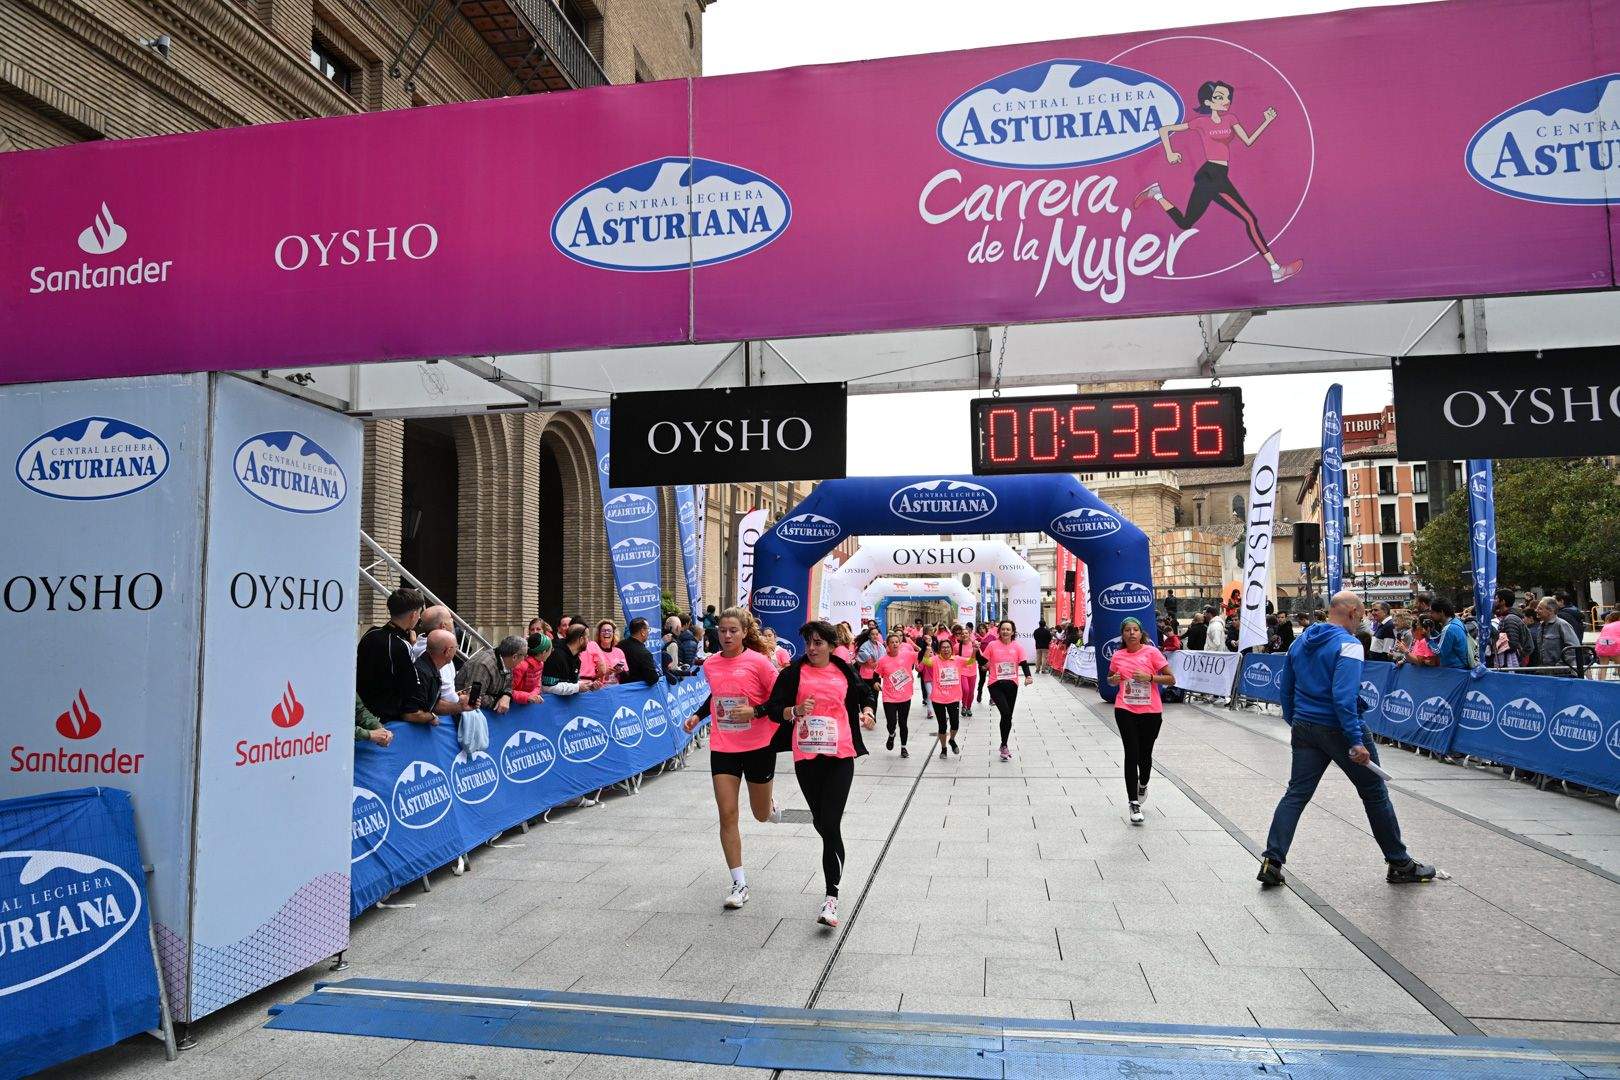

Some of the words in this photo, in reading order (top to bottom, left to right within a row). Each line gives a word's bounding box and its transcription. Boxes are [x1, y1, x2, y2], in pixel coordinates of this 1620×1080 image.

[992, 97, 1068, 113] CENTRAL
[1077, 89, 1156, 105] LECHERA
[956, 104, 1164, 147] ASTURIANA
[1536, 119, 1620, 138] CENTRA
[605, 194, 678, 213] CENTRAL
[686, 189, 764, 205] LECHERA
[918, 168, 1120, 225] Carrera
[568, 205, 773, 248] ASTURIANA
[29, 257, 173, 294] Santander
[274, 223, 439, 271] OYSHO
[967, 225, 1004, 264] de
[1013, 220, 1040, 262] la
[1035, 207, 1200, 304] Mujer
[1443, 384, 1620, 429] OYSH
[647, 416, 812, 455] OYSHO
[1344, 419, 1381, 433] TIBUR
[51, 445, 101, 456] CENTRAL
[104, 443, 154, 454] LECHERA
[26, 450, 158, 481] ASTURIANA
[242, 450, 340, 500] ASTURIANA
[261, 452, 301, 469] CENTRAL
[302, 461, 339, 477] LECHERA
[898, 493, 990, 513] ASTURIANA
[780, 524, 835, 537] ASTURIANA
[1056, 520, 1117, 533] ASTURIANA
[1246, 464, 1275, 611] OYSHO
[892, 547, 976, 566] OYSHO
[1, 572, 163, 613] OYSHO
[229, 572, 344, 613] OYSHO
[753, 595, 796, 608] ASTURIANA
[1102, 593, 1151, 605] ASTURIANA
[1183, 654, 1226, 675] OYSHO
[1500, 710, 1541, 732] ASTURIANA
[1552, 718, 1597, 743] ASTURIANA
[235, 731, 331, 767] Santander
[564, 734, 607, 756] ASTURIANA
[10, 745, 145, 775] Santander
[506, 749, 553, 776] ASTURIANA
[405, 784, 425, 796] CENTRAL
[455, 767, 497, 795] ASTURIANA
[398, 784, 451, 820] ASTURIANA
[31, 876, 112, 906] LECHERA
